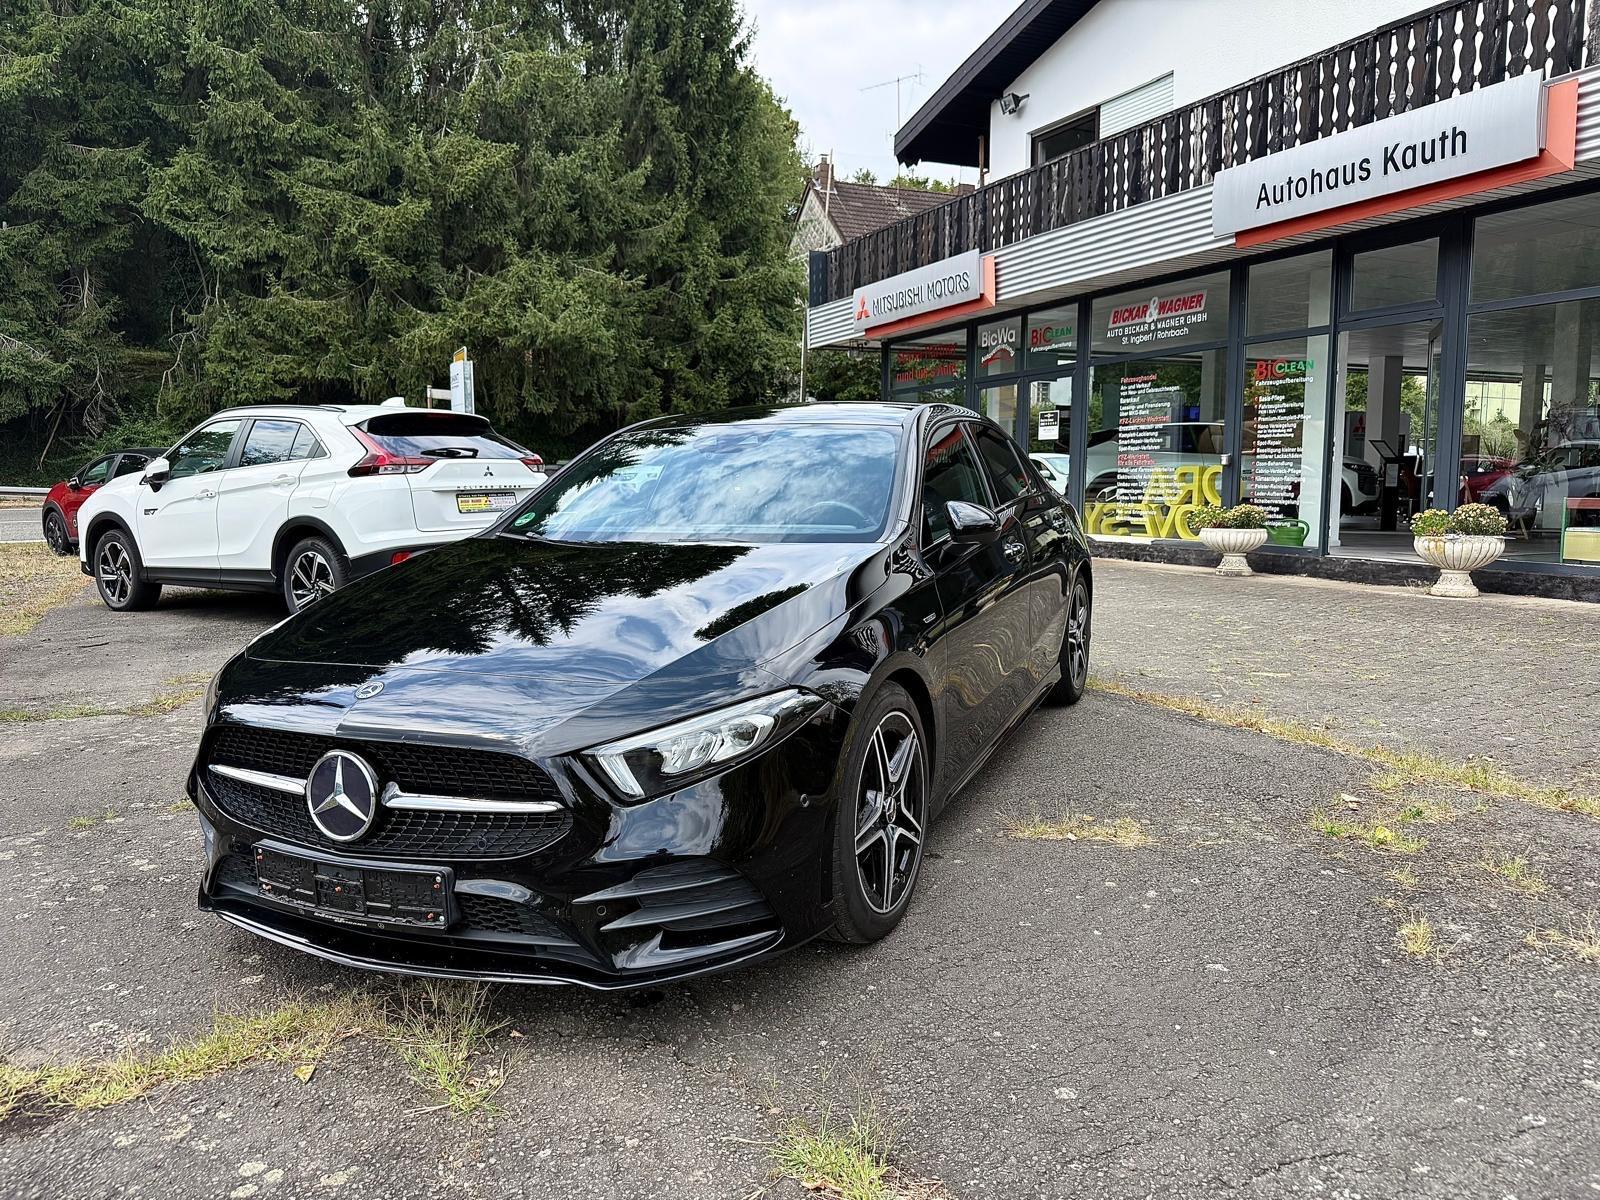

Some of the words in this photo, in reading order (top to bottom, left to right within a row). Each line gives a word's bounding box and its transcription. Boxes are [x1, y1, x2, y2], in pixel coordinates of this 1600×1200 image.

[1256, 157, 1371, 209] Autohaus
[1383, 126, 1467, 175] Kauth
[872, 285, 923, 317] MITSUBISHI
[927, 271, 970, 299] MOTORS
[1112, 304, 1148, 324] BICKAR
[1158, 293, 1204, 315] WAGNER
[982, 327, 1016, 348] BicWa
[1107, 328, 1122, 338] AUTO
[1124, 324, 1148, 334] BICKAR
[1157, 316, 1184, 329] WAGNER
[1187, 312, 1208, 324] GMBH
[1157, 327, 1188, 339] Rohrbach
[1256, 376, 1314, 386] Fahrzeugaufbereitung
